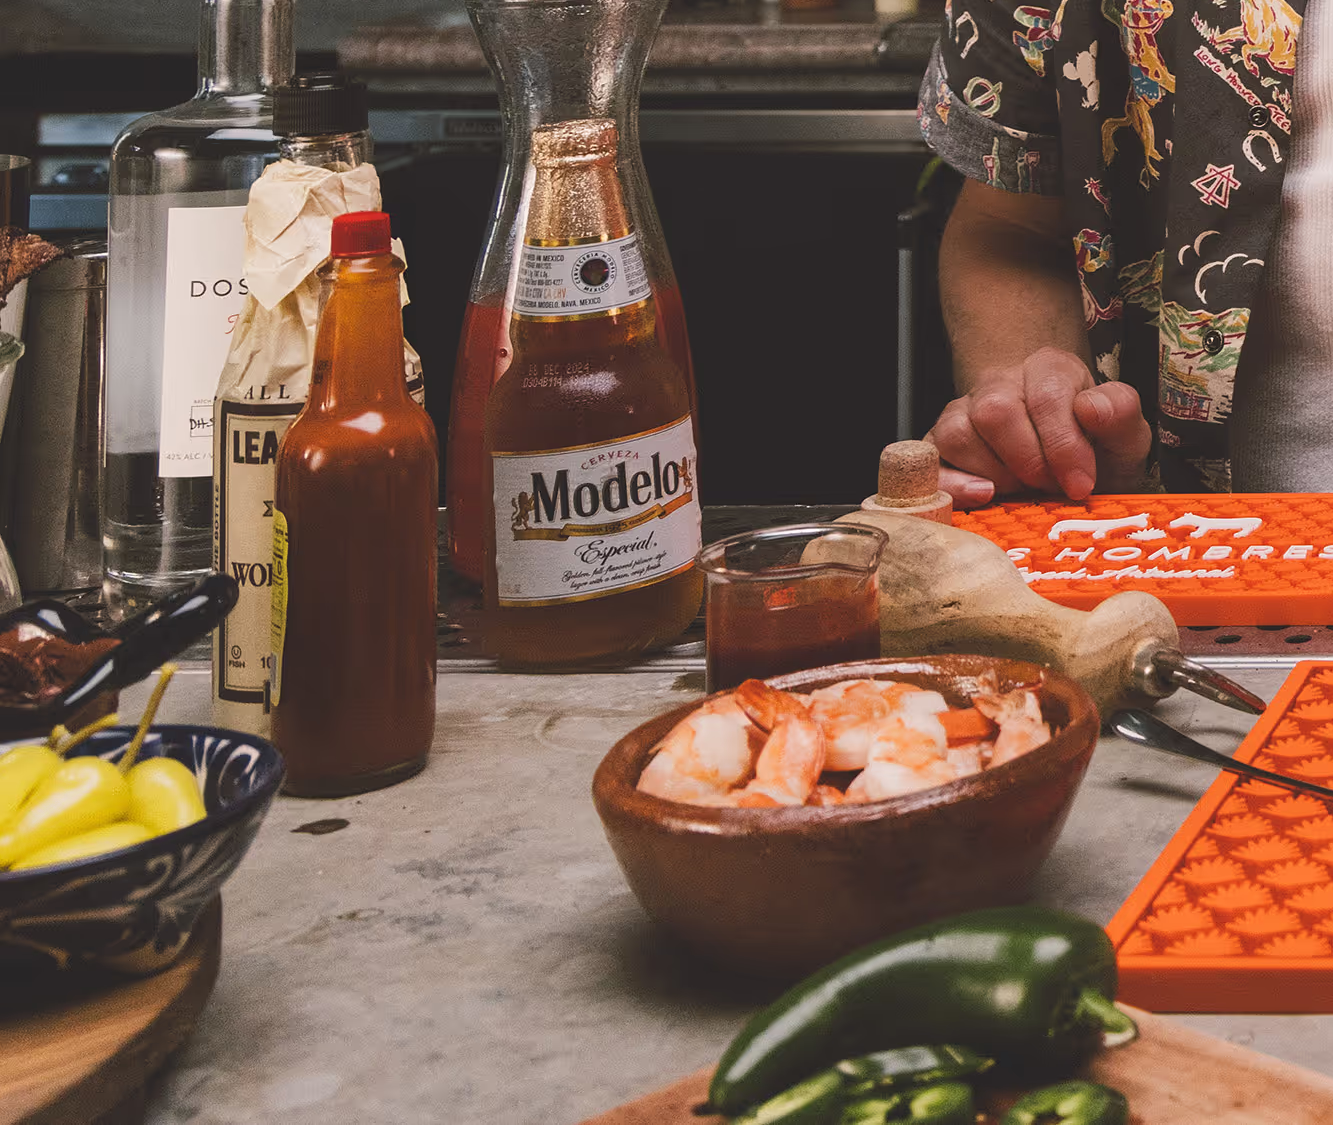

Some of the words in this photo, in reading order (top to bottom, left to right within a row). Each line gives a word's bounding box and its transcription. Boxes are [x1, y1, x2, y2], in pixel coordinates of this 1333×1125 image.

[1196, 51, 1222, 74] LONG
[191, 279, 249, 297] DOS
[244, 384, 291, 400] ALL
[233, 430, 279, 465] LEA
[580, 449, 640, 471] CERVEZA
[531, 451, 679, 524] Modelo
[229, 660, 245, 669] FISH
